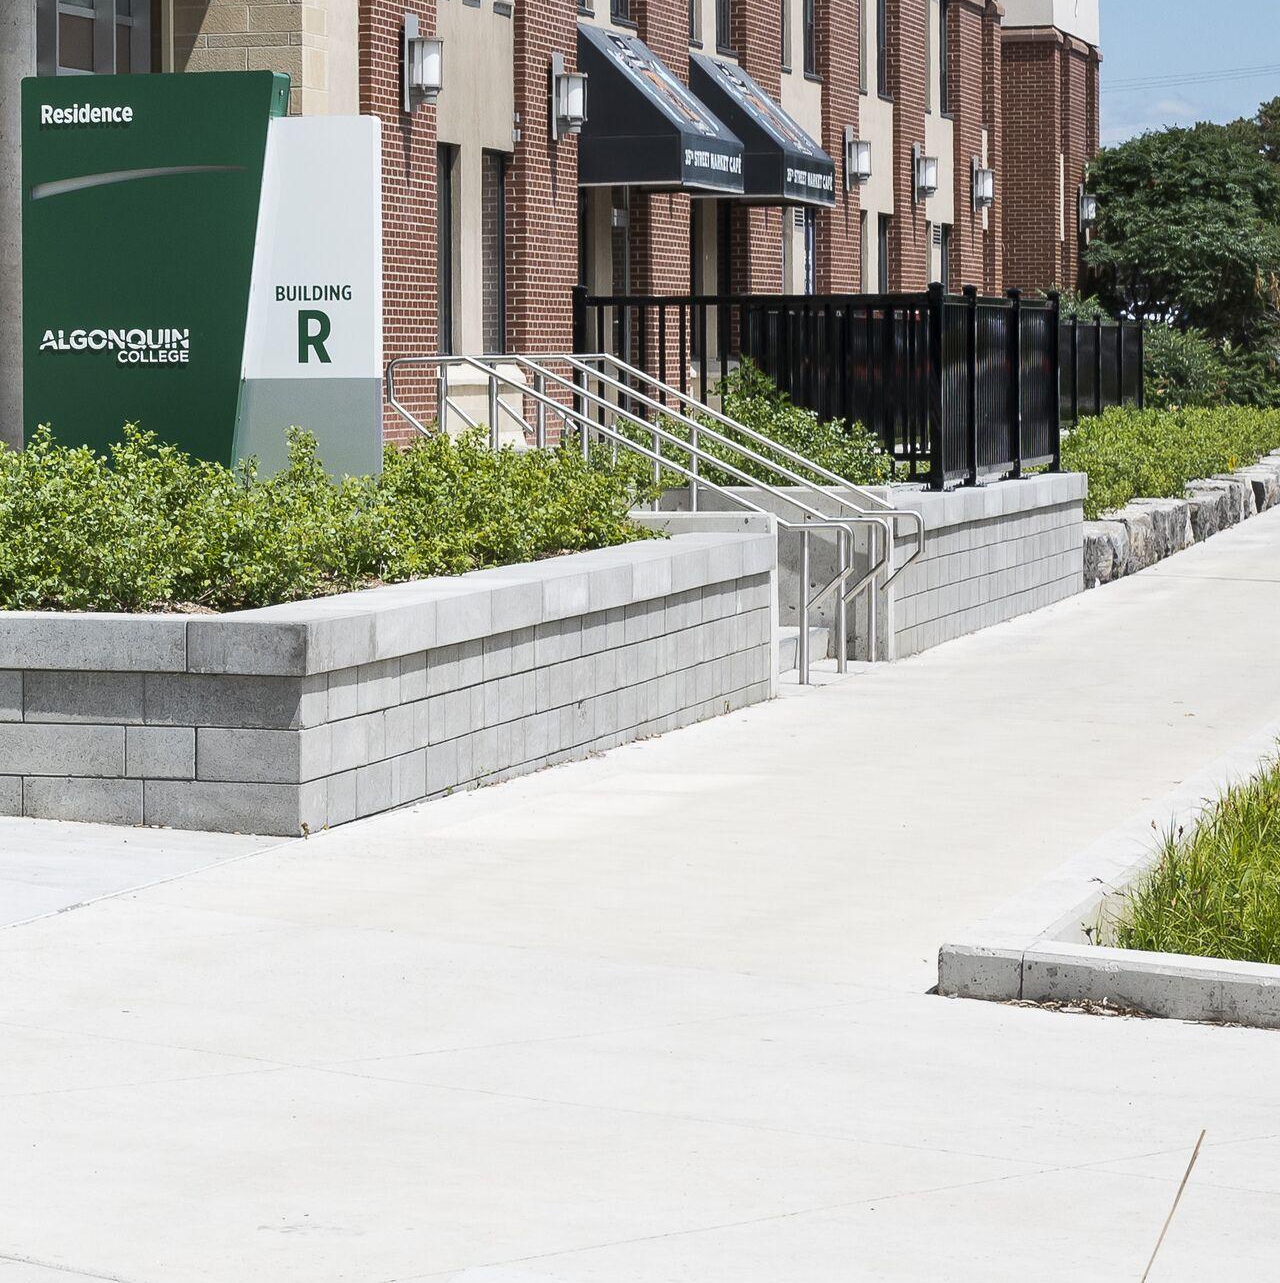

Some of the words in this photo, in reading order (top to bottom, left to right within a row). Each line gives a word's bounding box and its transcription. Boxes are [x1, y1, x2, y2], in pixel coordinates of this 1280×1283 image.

[41, 103, 134, 124] Residence
[694, 150, 710, 167] STREET
[710, 153, 729, 172] MARKET
[729, 153, 742, 174] CAFÉ
[794, 169, 807, 186] STREET
[807, 172, 823, 189] MARKET
[823, 171, 833, 191] CAFÉ
[276, 285, 352, 301] BUILDING
[40, 328, 189, 350] ALGONQUIN
[298, 310, 332, 363] R
[118, 350, 189, 363] COLLEGE
